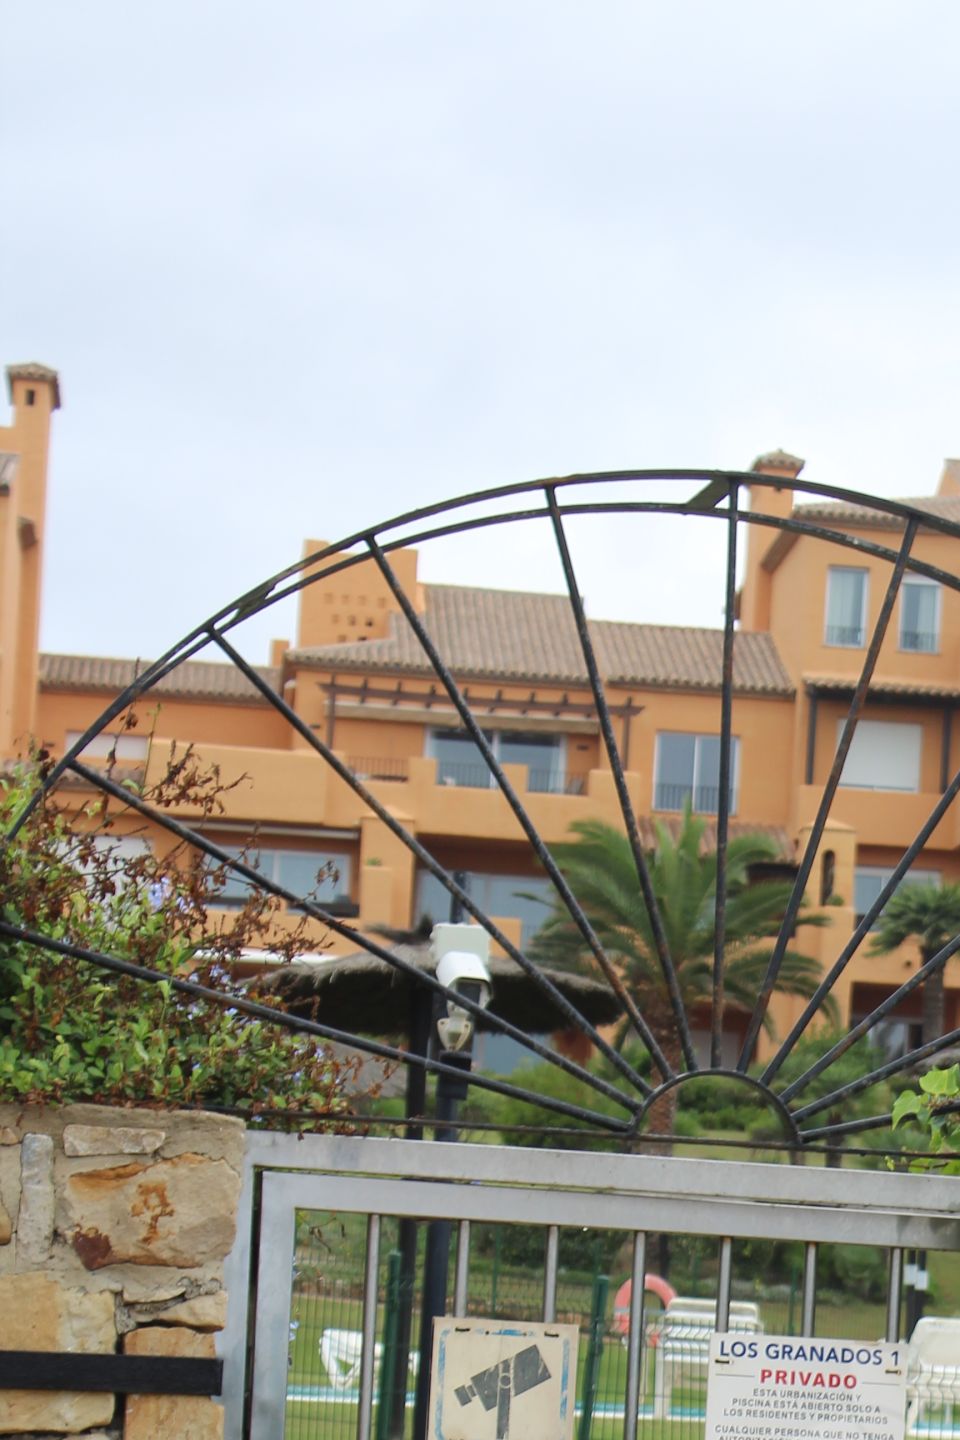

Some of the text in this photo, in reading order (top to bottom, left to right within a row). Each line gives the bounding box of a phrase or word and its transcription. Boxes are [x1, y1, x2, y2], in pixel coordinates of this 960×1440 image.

[720, 1341, 899, 1366] LOS GRANADOS 1
[760, 1369, 857, 1388] PRIVADO
[753, 1388, 777, 1397] ESTA
[780, 1389, 853, 1401] URBANIZACIÓN
[732, 1398, 770, 1408] PISCINA
[801, 1402, 843, 1412] ABIERTO
[846, 1404, 872, 1413] SOLO
[724, 1409, 887, 1424] LOS RESIDENTES Y PROPIETARIOS
[715, 1425, 894, 1440] CUALQUIER PERSONA QUE NO TENGA
